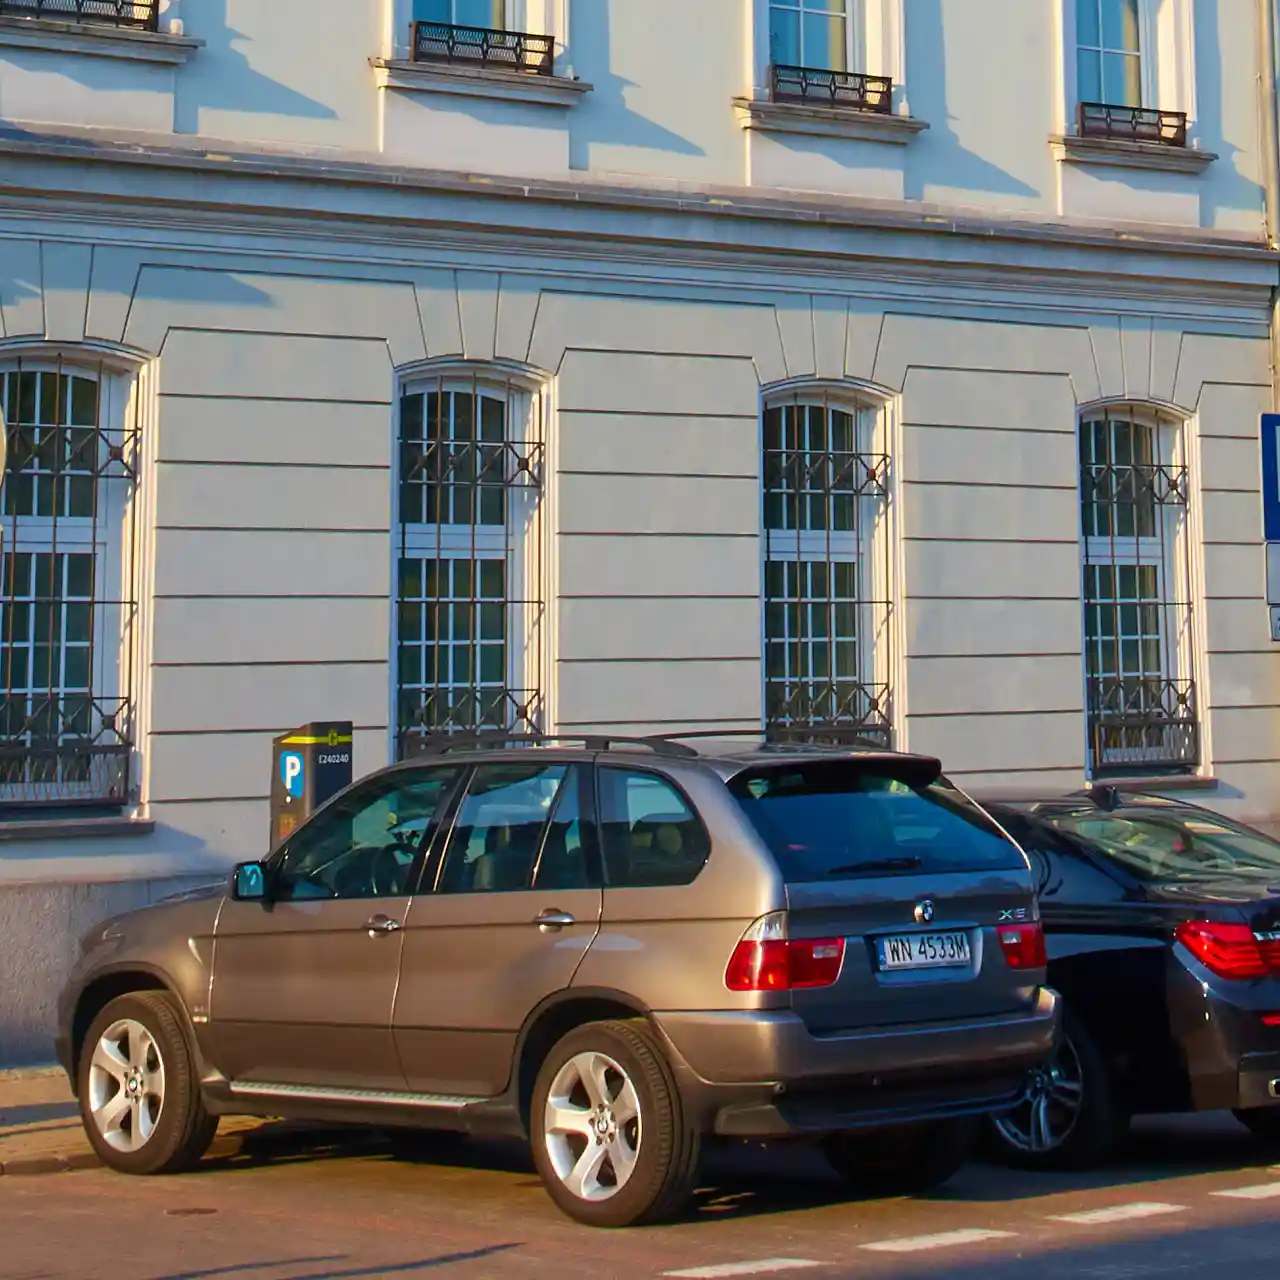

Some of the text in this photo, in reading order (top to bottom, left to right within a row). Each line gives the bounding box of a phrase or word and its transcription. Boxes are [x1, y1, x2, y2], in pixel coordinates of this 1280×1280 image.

[286, 755, 301, 790] P
[888, 934, 968, 962] WN 4533M
